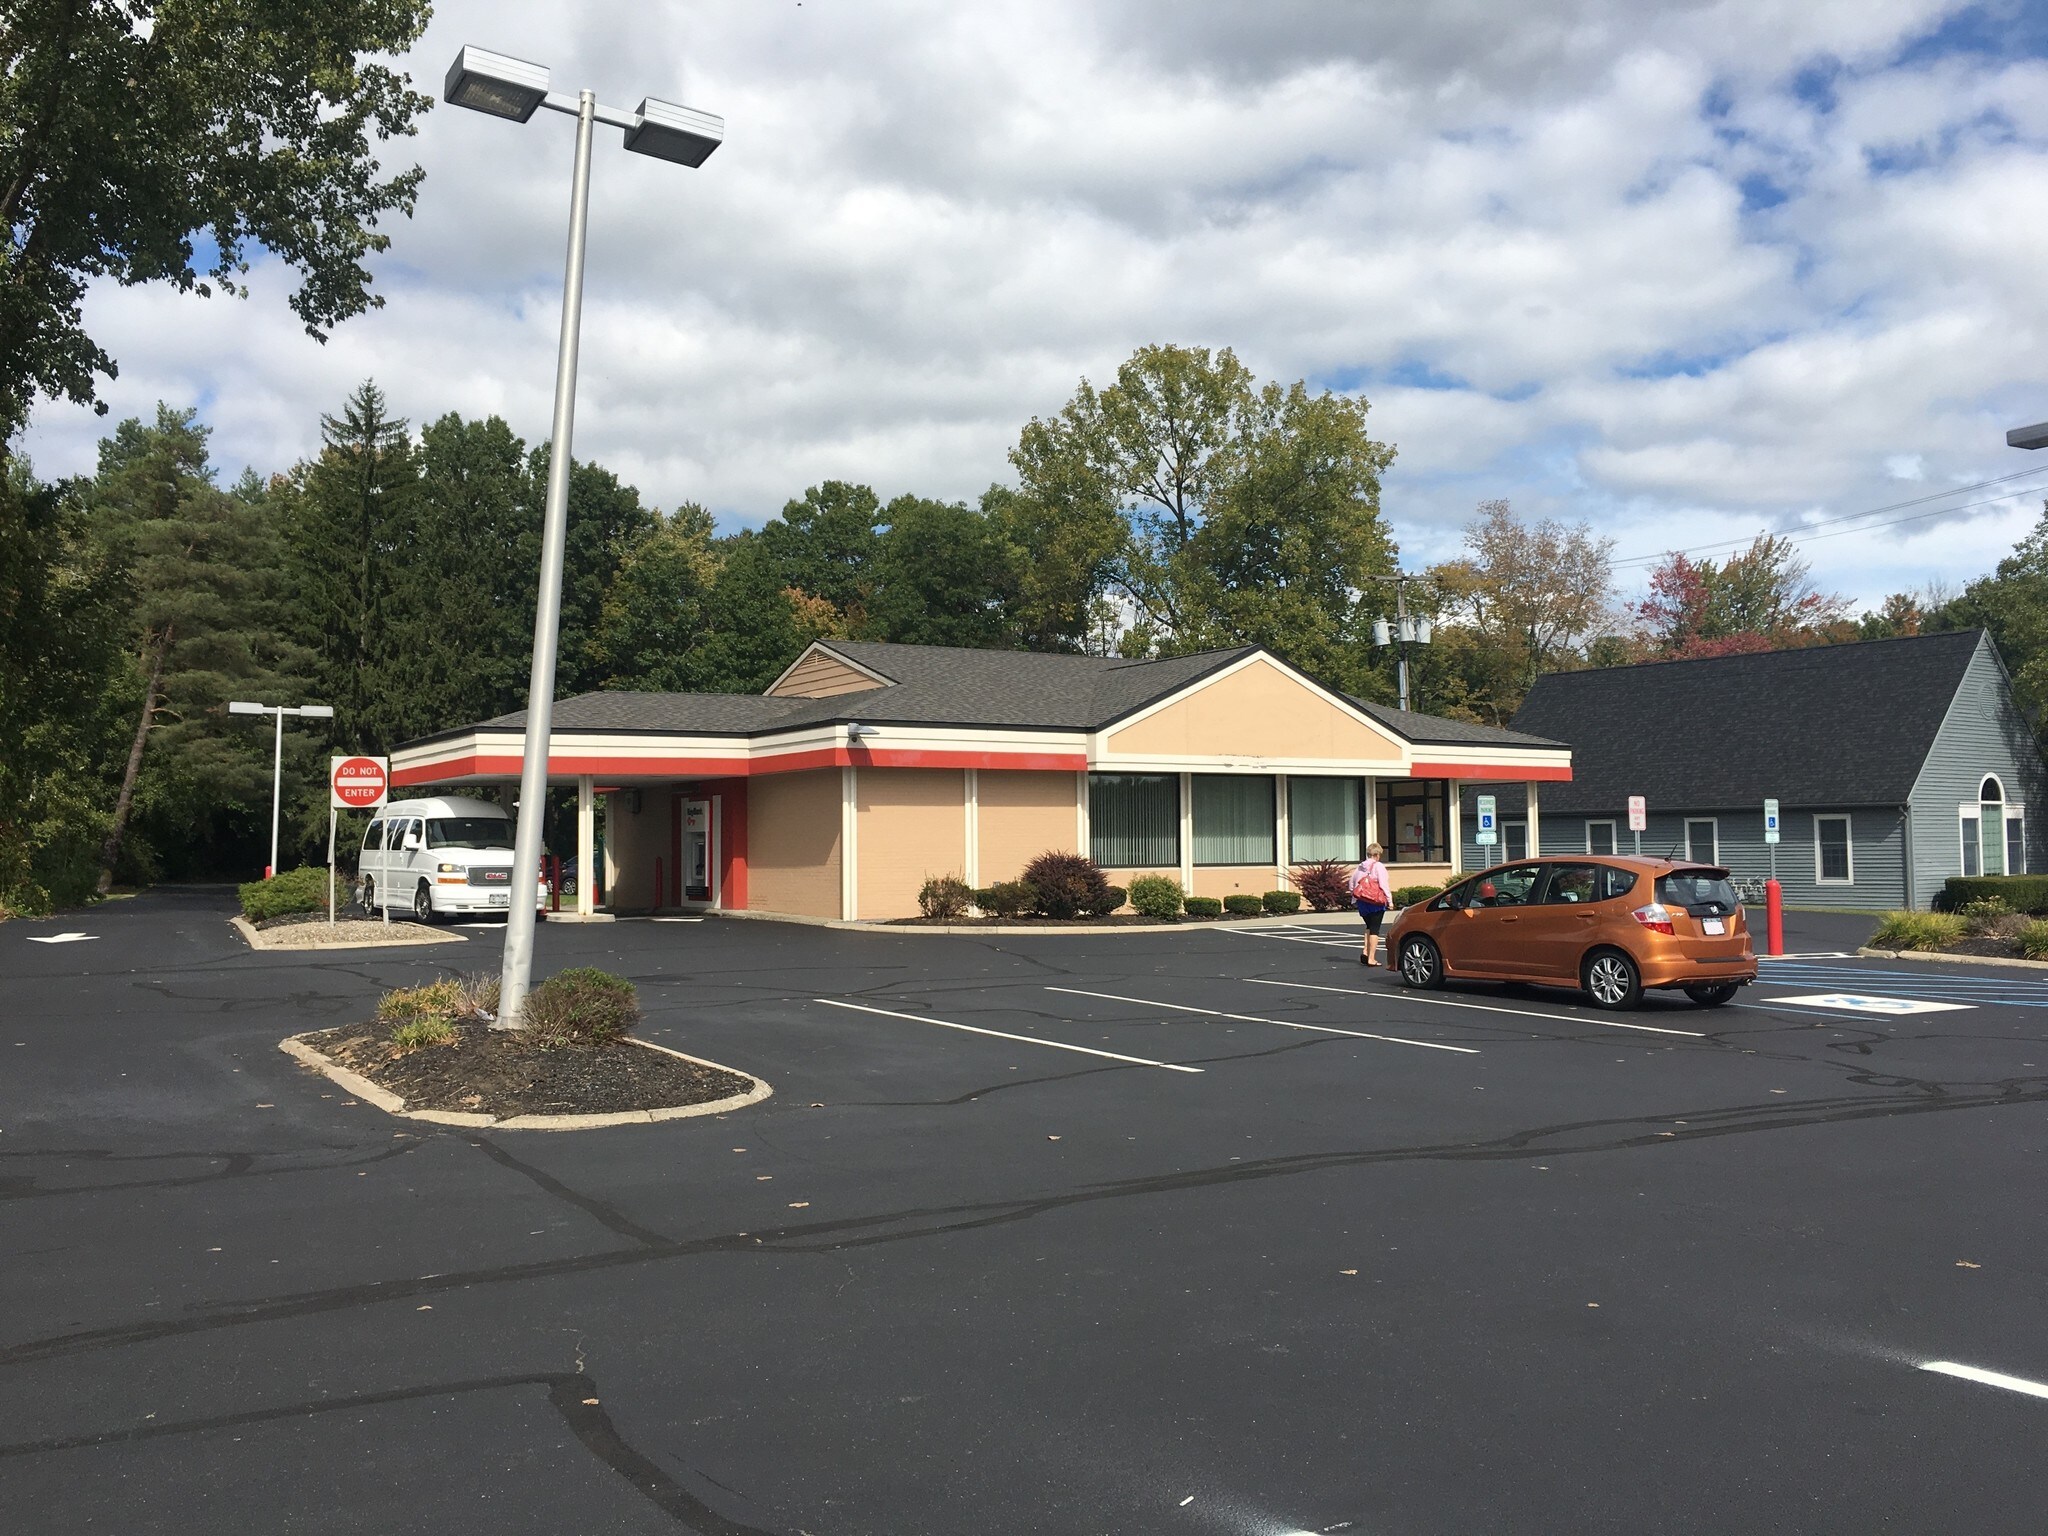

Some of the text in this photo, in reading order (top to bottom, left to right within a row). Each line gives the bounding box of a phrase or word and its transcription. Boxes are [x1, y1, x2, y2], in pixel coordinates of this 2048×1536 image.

[342, 767, 378, 776] DO NOT
[345, 788, 375, 797] ENTER
